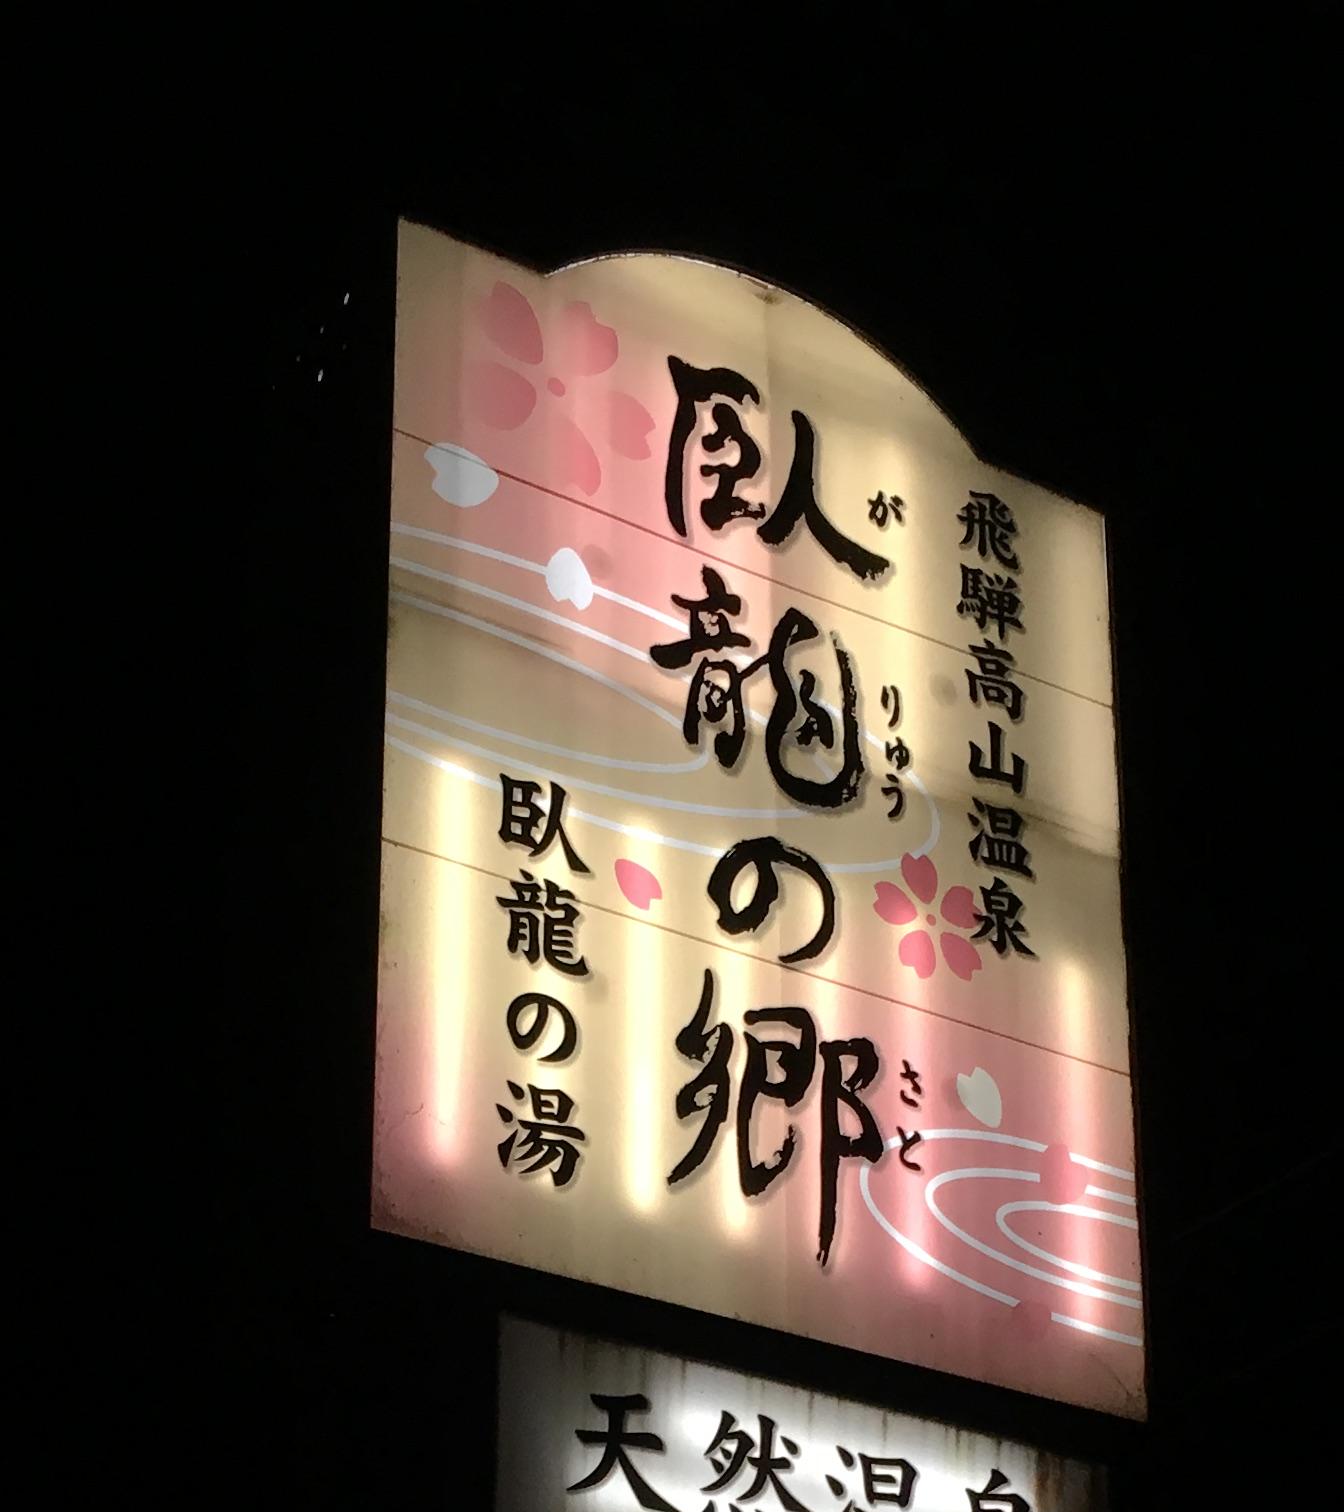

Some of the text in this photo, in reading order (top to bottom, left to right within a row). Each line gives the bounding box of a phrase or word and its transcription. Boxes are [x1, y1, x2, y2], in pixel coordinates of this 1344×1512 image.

[650, 355, 889, 1268] 臥龍の郷
[957, 490, 1036, 959] 飛騨高山温泉
[496, 773, 590, 1187] 臥龍の湯
[897, 1060, 924, 1172] さと
